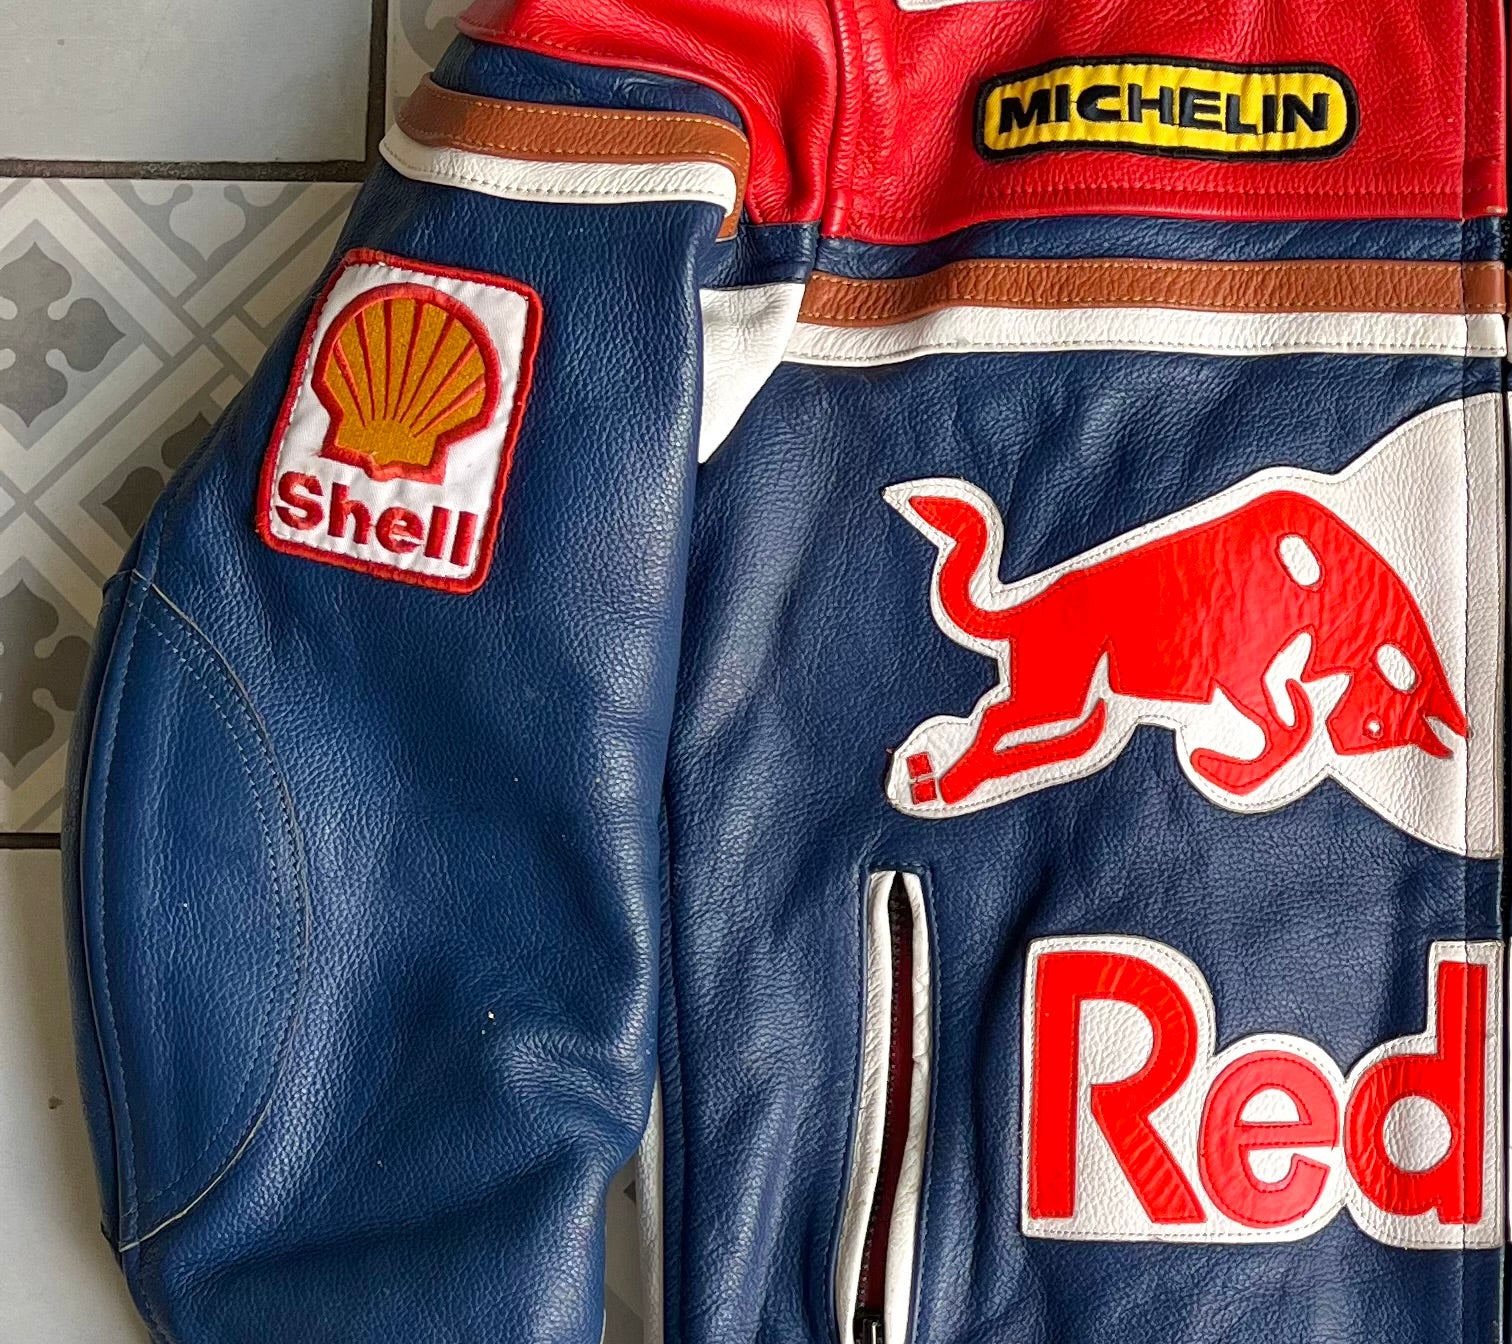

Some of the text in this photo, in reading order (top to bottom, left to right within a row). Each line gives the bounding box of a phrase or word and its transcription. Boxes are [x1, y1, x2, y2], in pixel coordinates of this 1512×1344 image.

[999, 83, 1329, 134] MICHELIN
[275, 471, 478, 567] Shell
[1029, 951, 1484, 1229] Red
